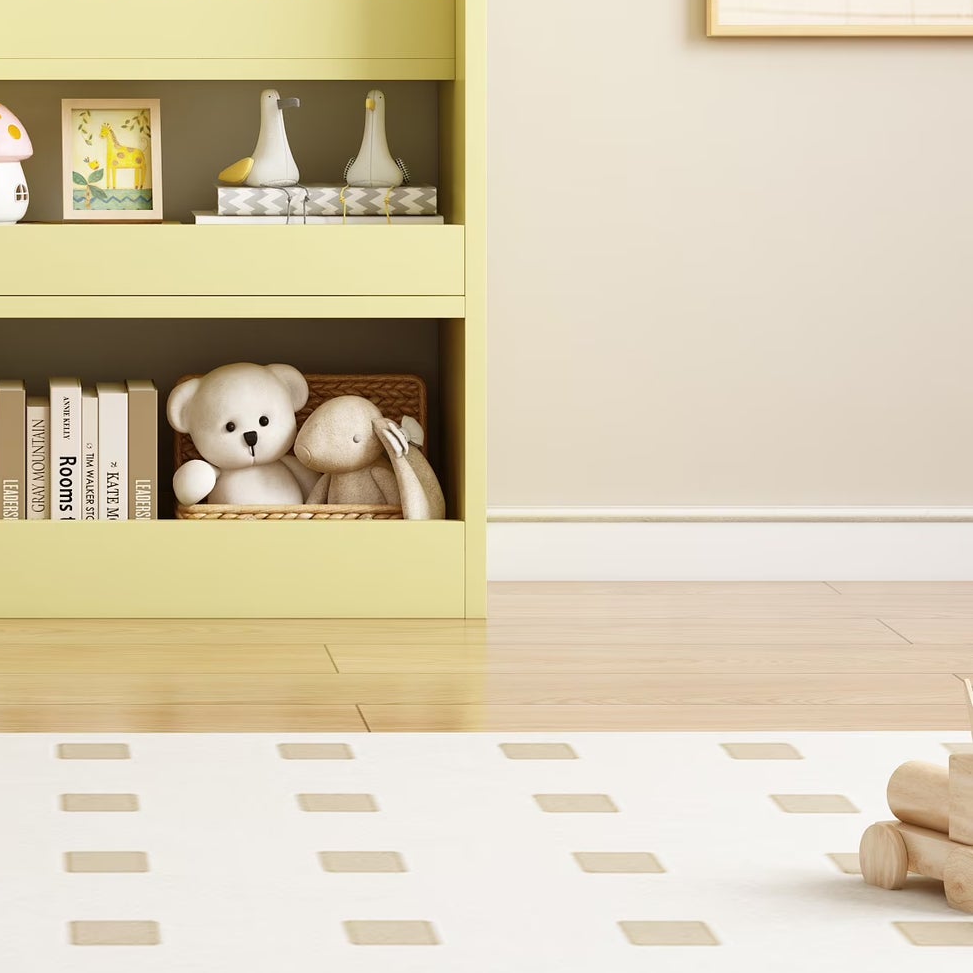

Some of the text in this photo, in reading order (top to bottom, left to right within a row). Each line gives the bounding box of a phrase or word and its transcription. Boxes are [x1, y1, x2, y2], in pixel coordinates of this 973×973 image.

[62, 396, 70, 440] ANNIE KELLY
[31, 419, 46, 513] GRAY MOUNTAIN
[85, 453, 94, 468] TIM
[59, 456, 77, 512] Rooms
[85, 470, 94, 505] WALKER
[106, 471, 119, 520] KATE M
